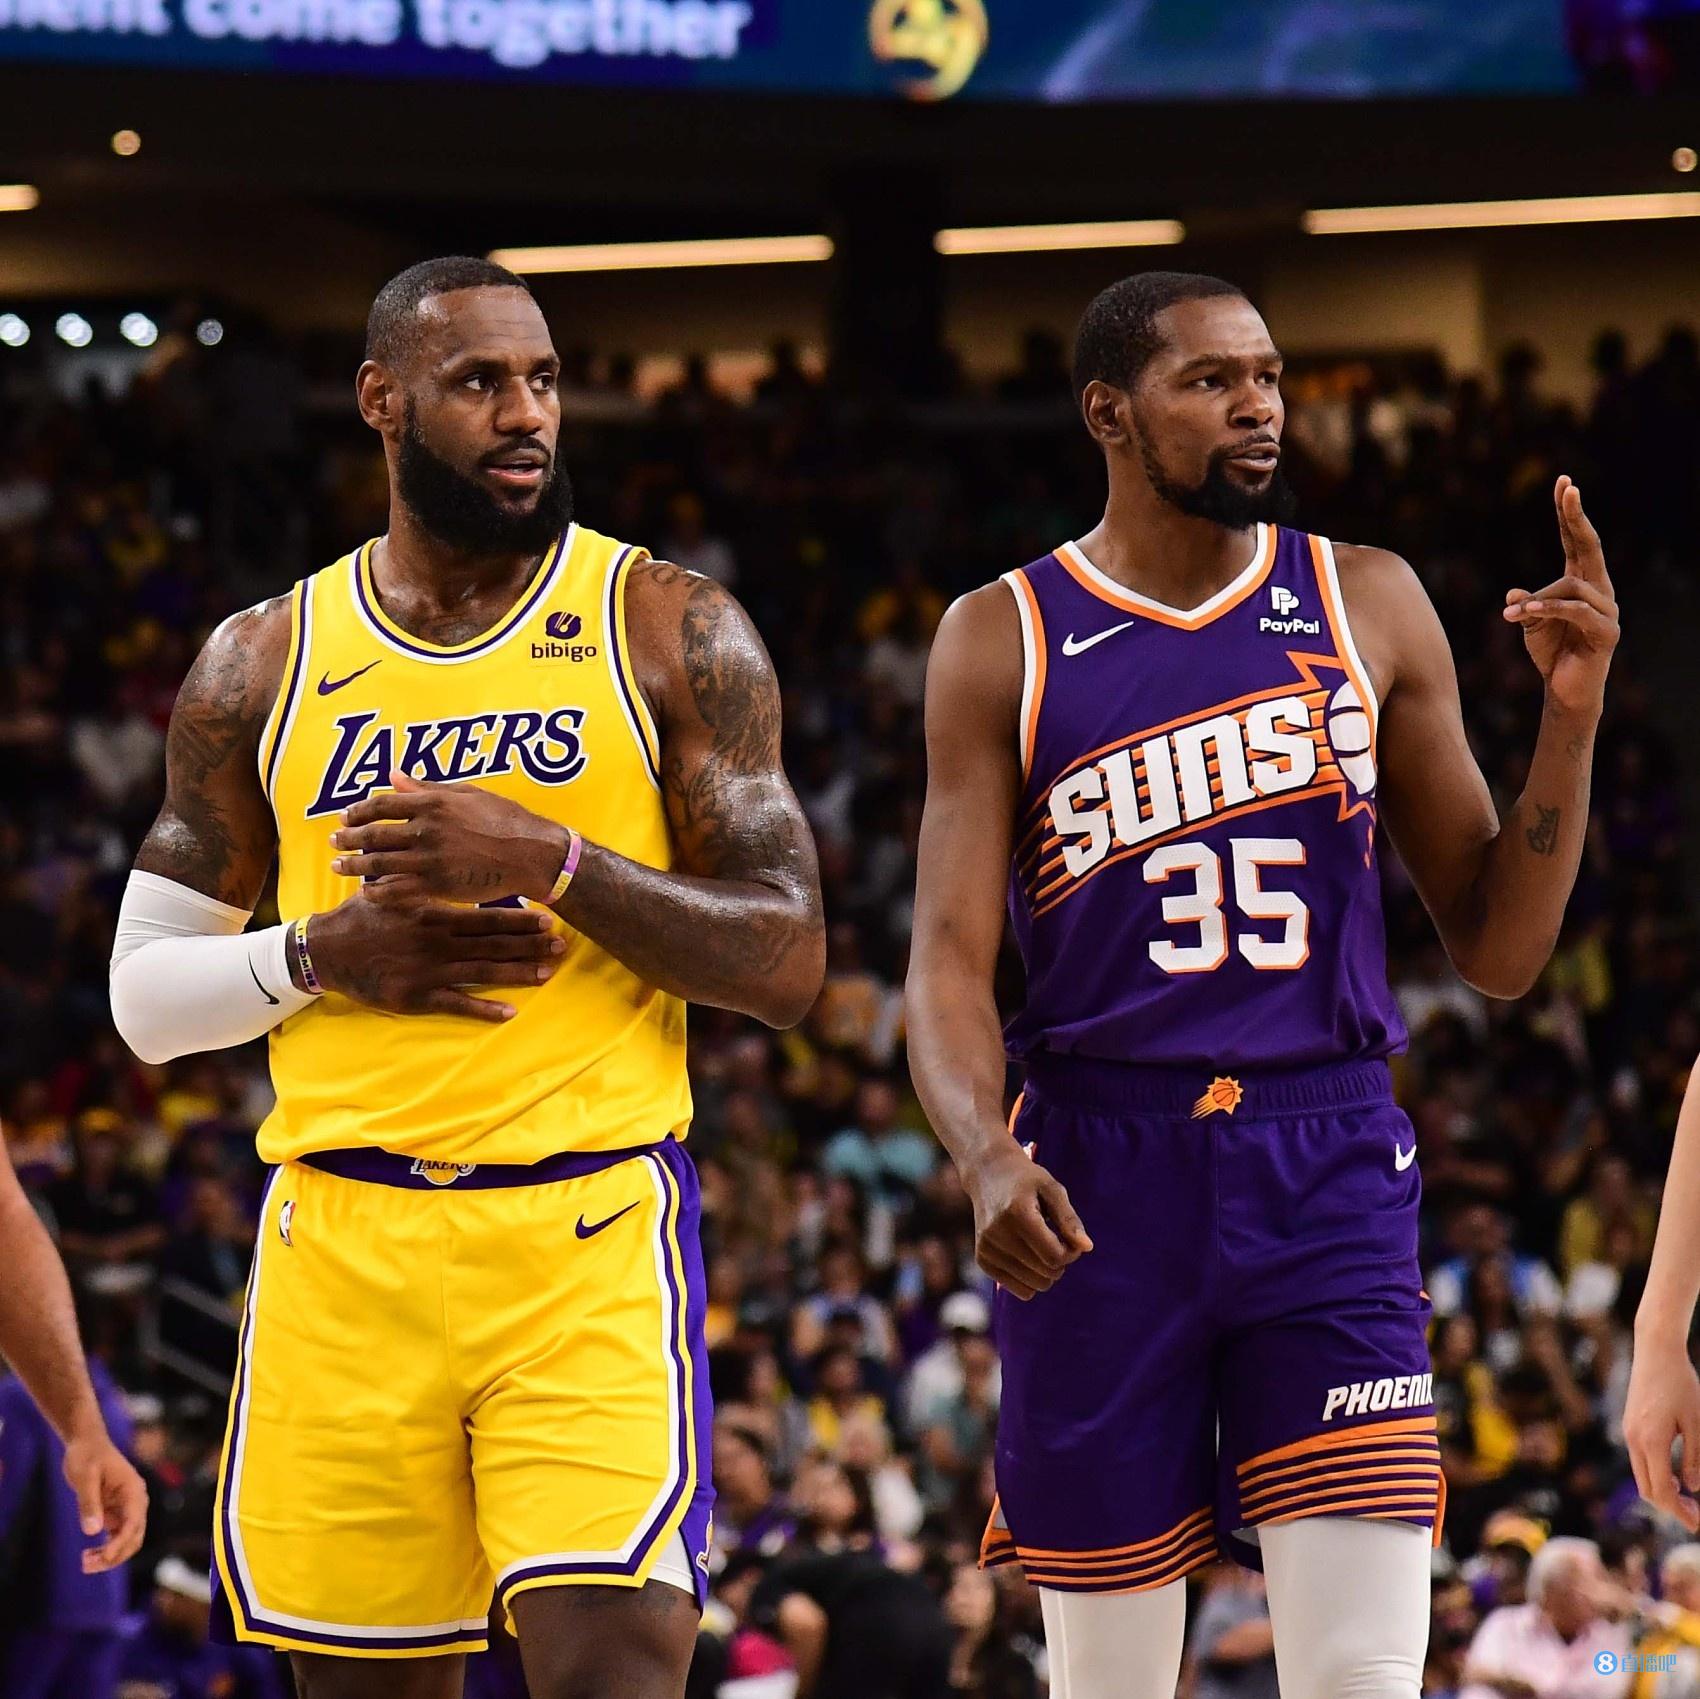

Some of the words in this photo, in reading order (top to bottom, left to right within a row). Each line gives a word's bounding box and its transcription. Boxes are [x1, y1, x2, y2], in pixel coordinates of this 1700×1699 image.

[182, 0, 399, 45] come
[406, 0, 752, 67] together
[531, 642, 597, 662] bibigo
[1260, 617, 1320, 634] PayPal
[304, 705, 589, 820] LAKERS
[1049, 696, 1316, 878] SUNS
[1143, 838, 1310, 974] 35
